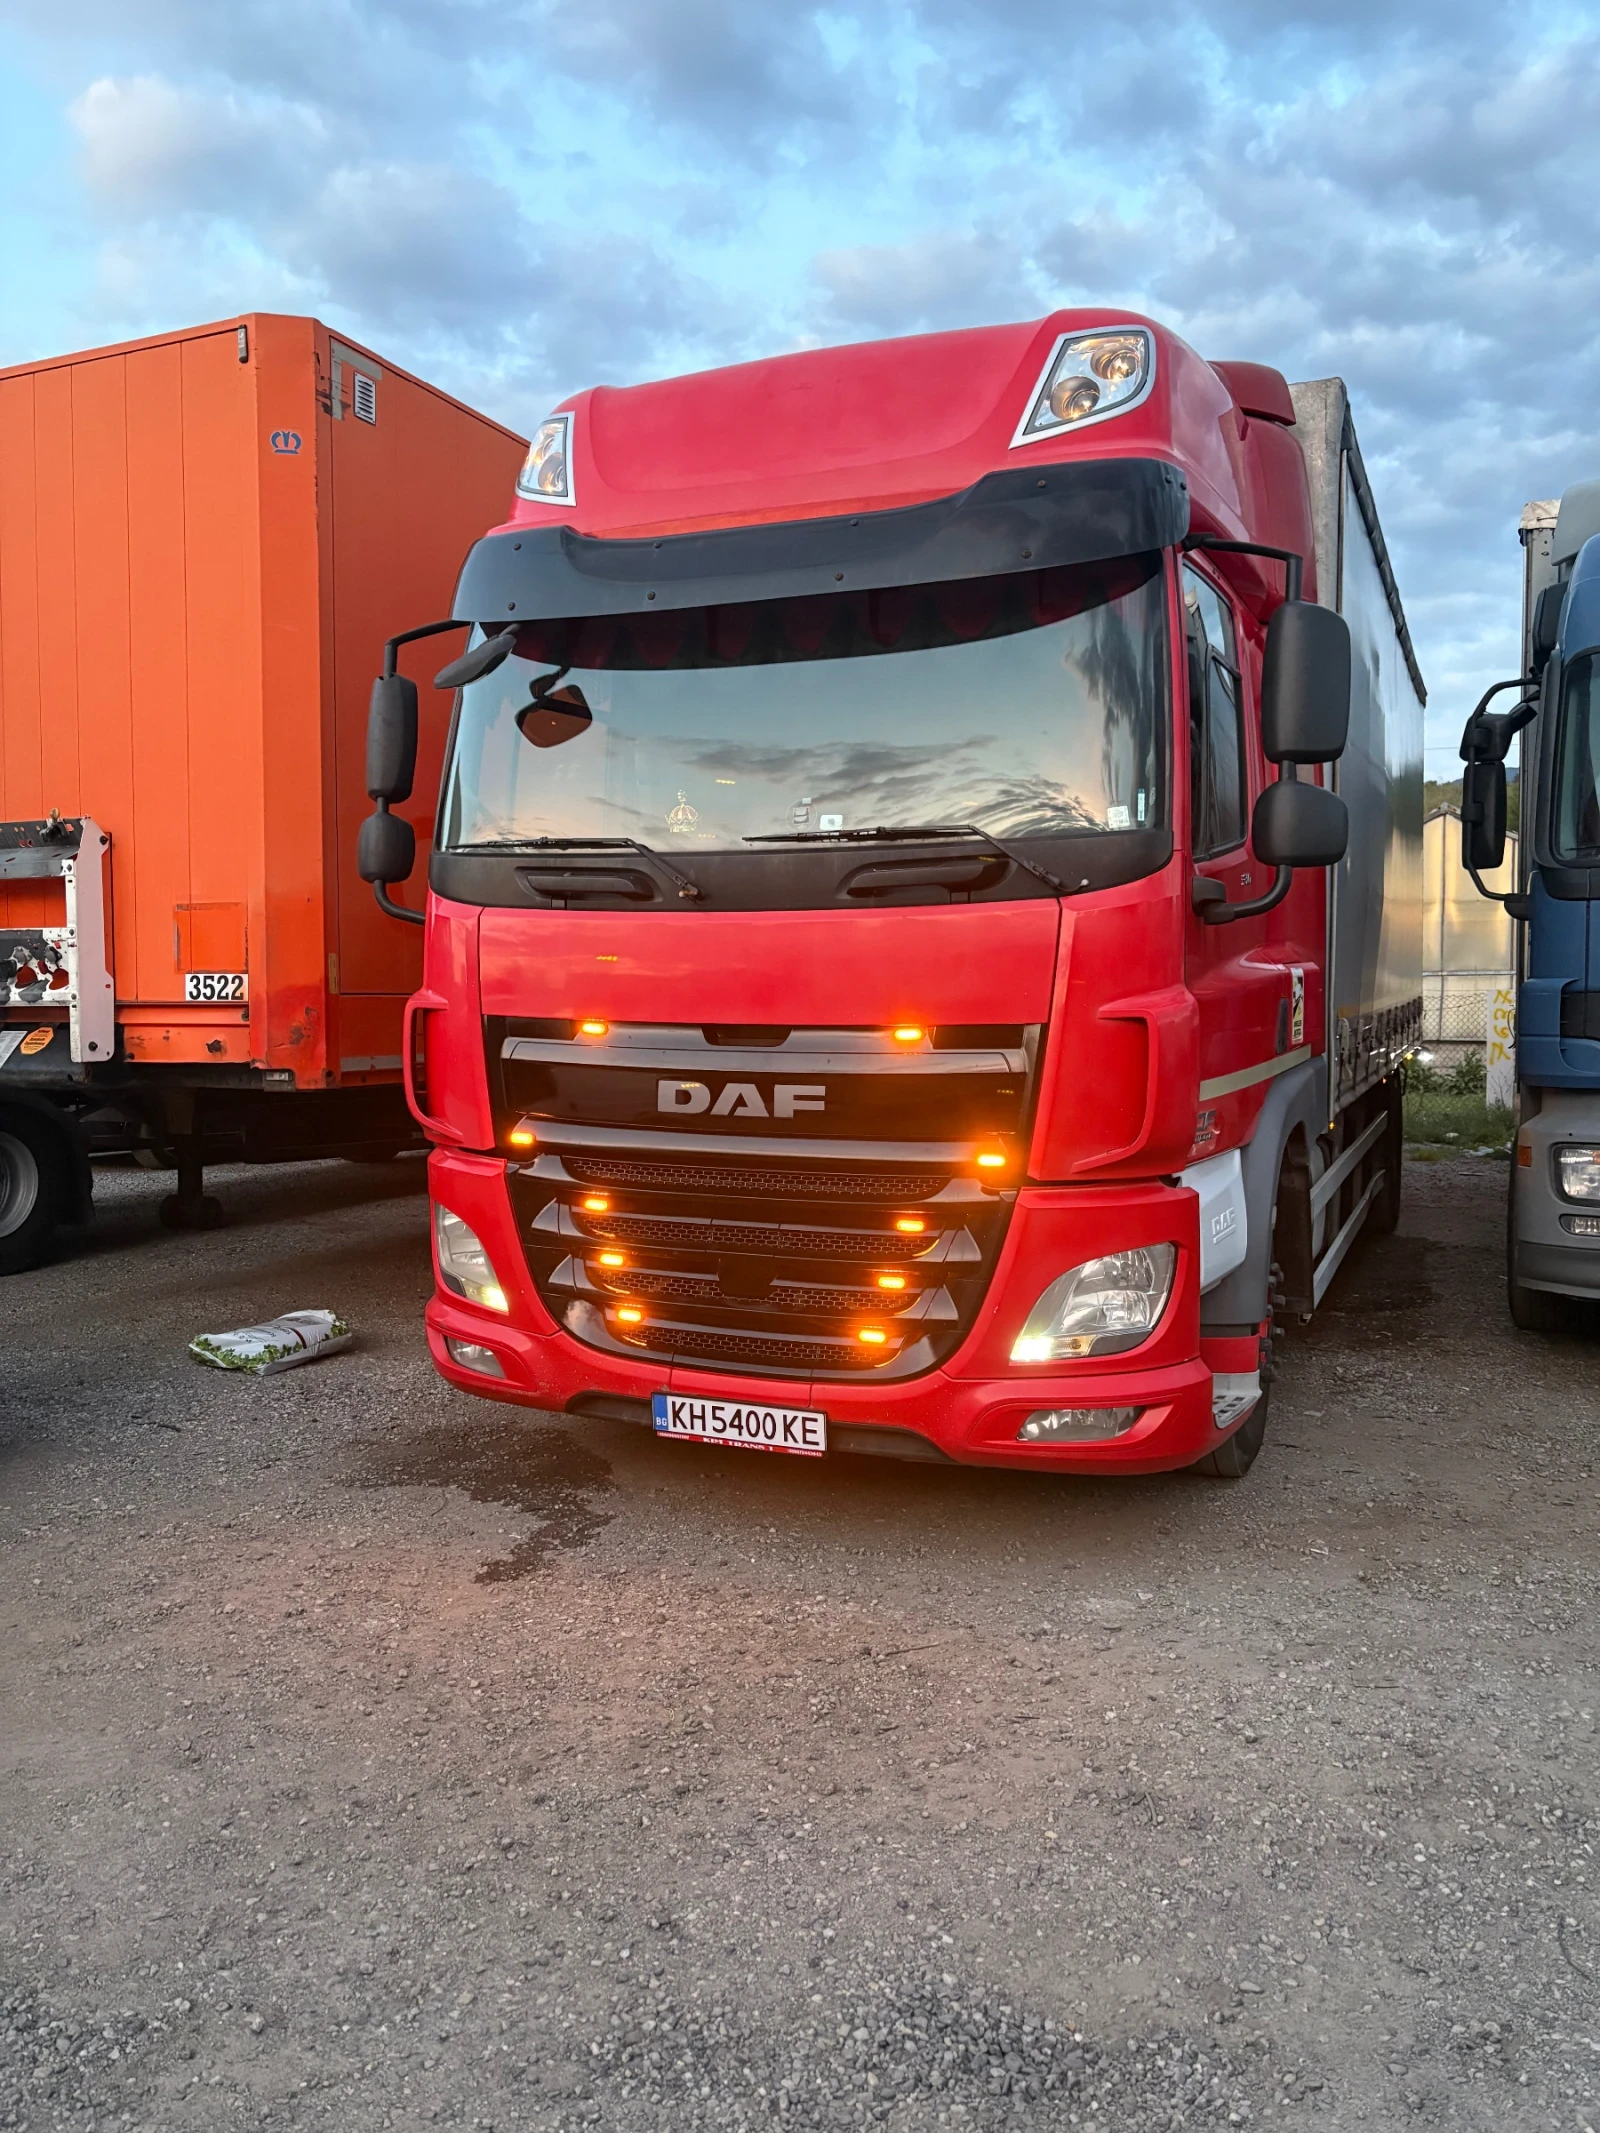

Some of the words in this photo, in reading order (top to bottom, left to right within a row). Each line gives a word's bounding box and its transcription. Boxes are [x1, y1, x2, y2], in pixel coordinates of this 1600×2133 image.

[189, 975, 244, 1000] 3522
[657, 1080, 826, 1118] DAF
[656, 1416, 668, 1426] BG
[728, 1440, 766, 1450] TRANS
